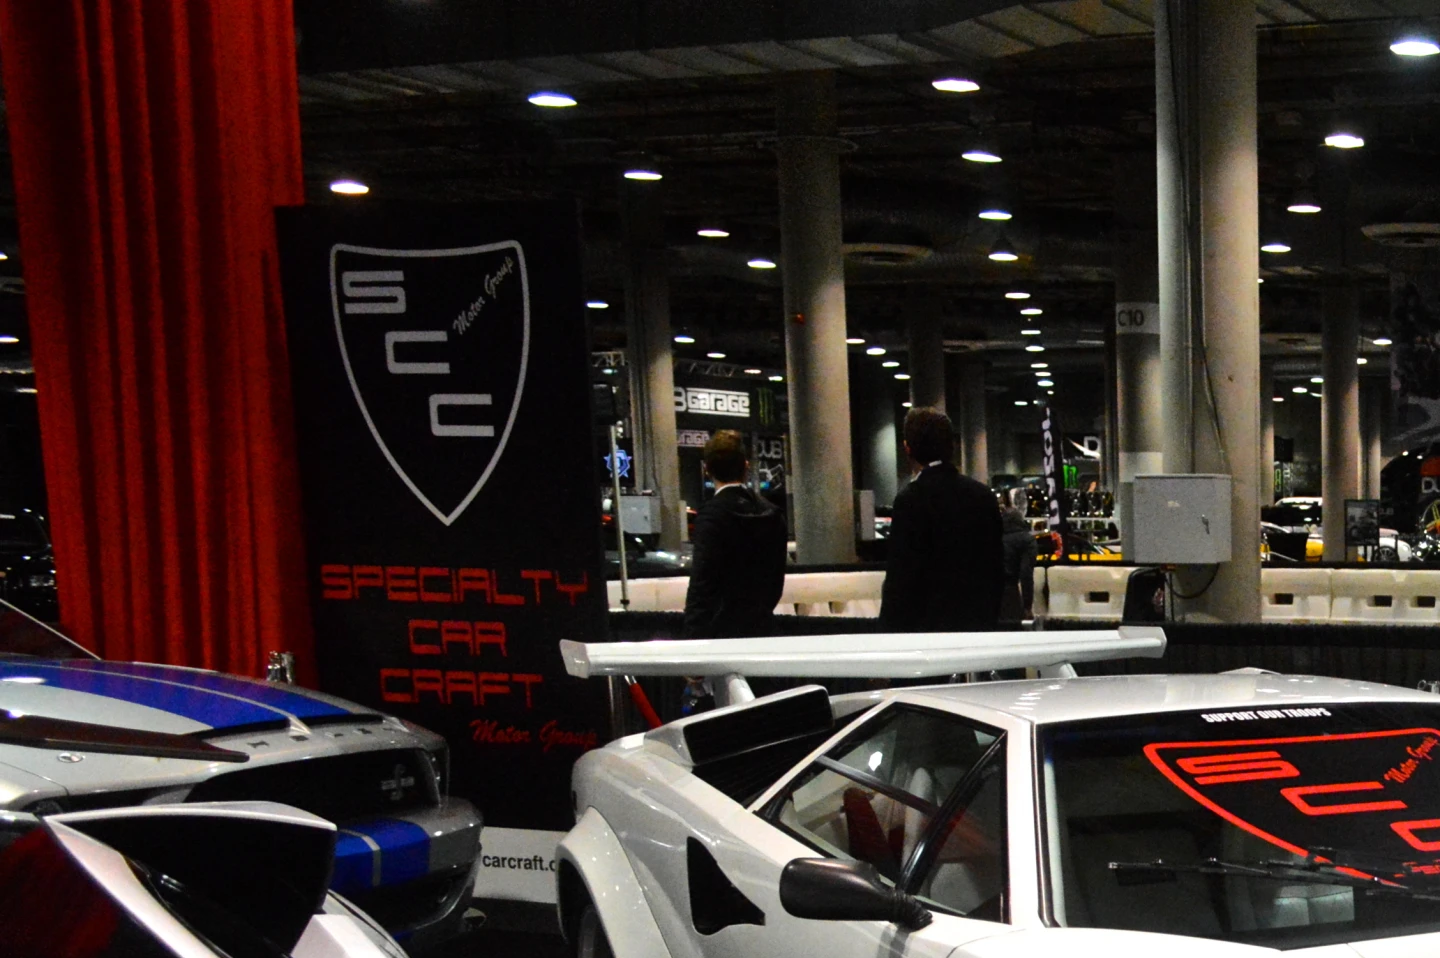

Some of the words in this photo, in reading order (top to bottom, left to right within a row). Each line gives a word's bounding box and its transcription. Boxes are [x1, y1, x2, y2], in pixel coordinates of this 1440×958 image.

[452, 296, 486, 336] Motor
[1117, 308, 1145, 327] C10
[321, 564, 589, 606] SPECIALTY
[408, 619, 508, 657] CAR
[380, 668, 543, 708] CRAFT
[1201, 710, 1259, 723] SUPPORT
[1256, 709, 1286, 719] OUR
[1281, 707, 1332, 718] TROOPS
[470, 718, 531, 743] Motor
[539, 720, 598, 752] Group
